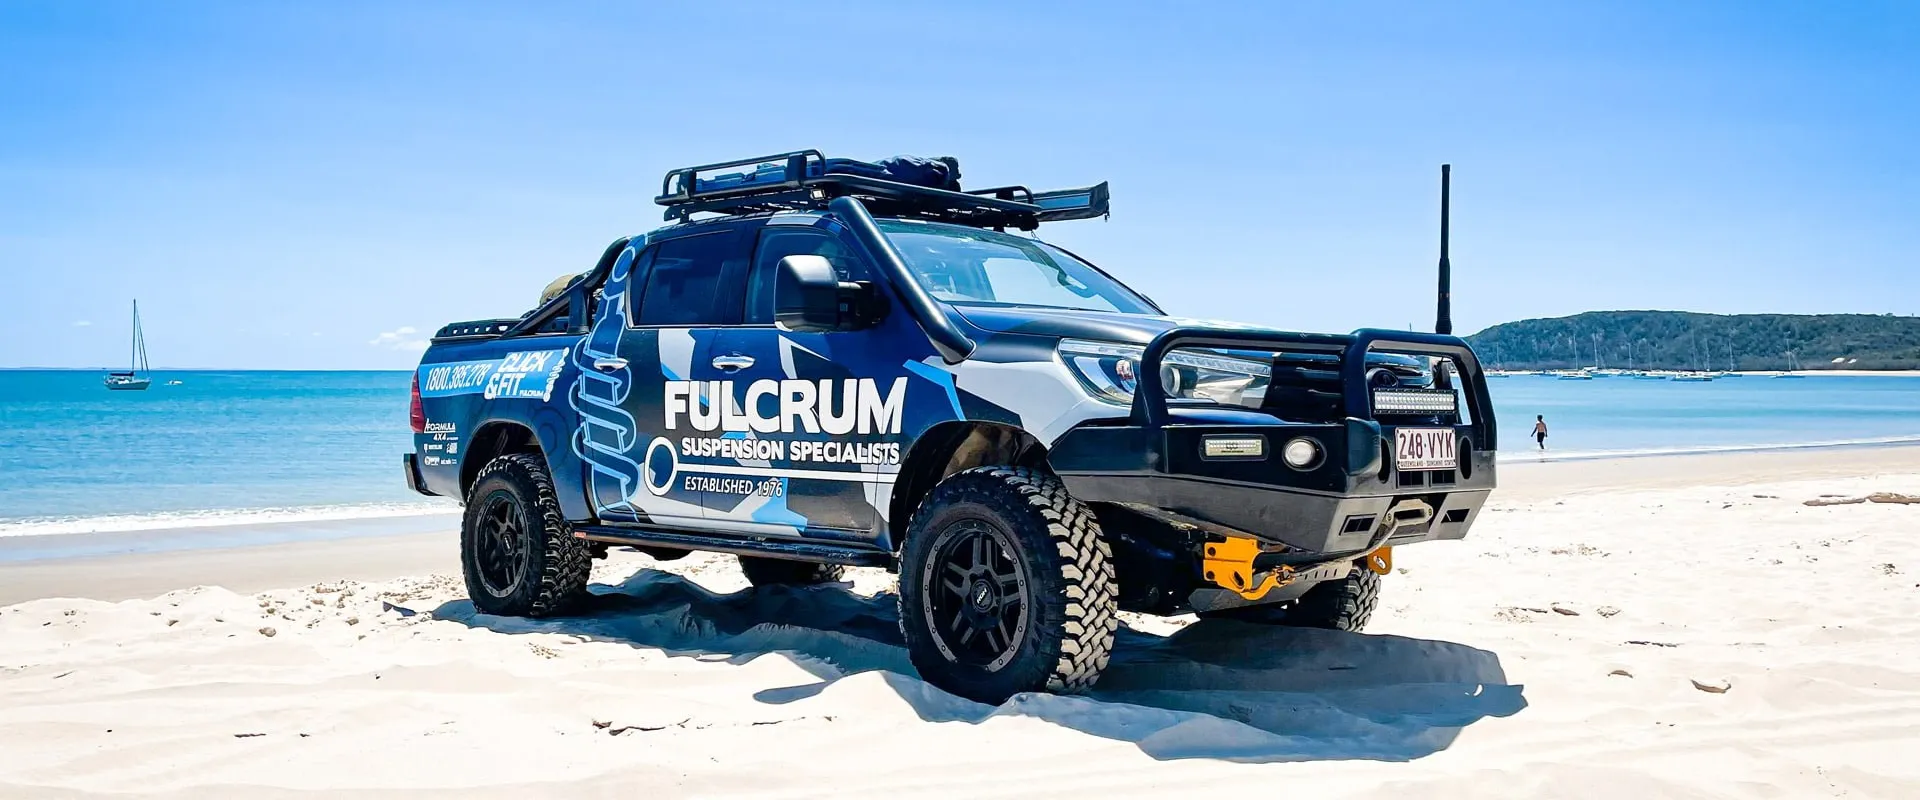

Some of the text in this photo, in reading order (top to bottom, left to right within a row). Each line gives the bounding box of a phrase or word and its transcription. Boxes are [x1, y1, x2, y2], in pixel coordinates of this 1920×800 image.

[498, 351, 553, 372] CLICK
[664, 377, 908, 435] FULCRUM
[681, 437, 900, 465] SUSPENSION SPECIALISTS
[684, 476, 783, 497] ESTABLISHED 1976
